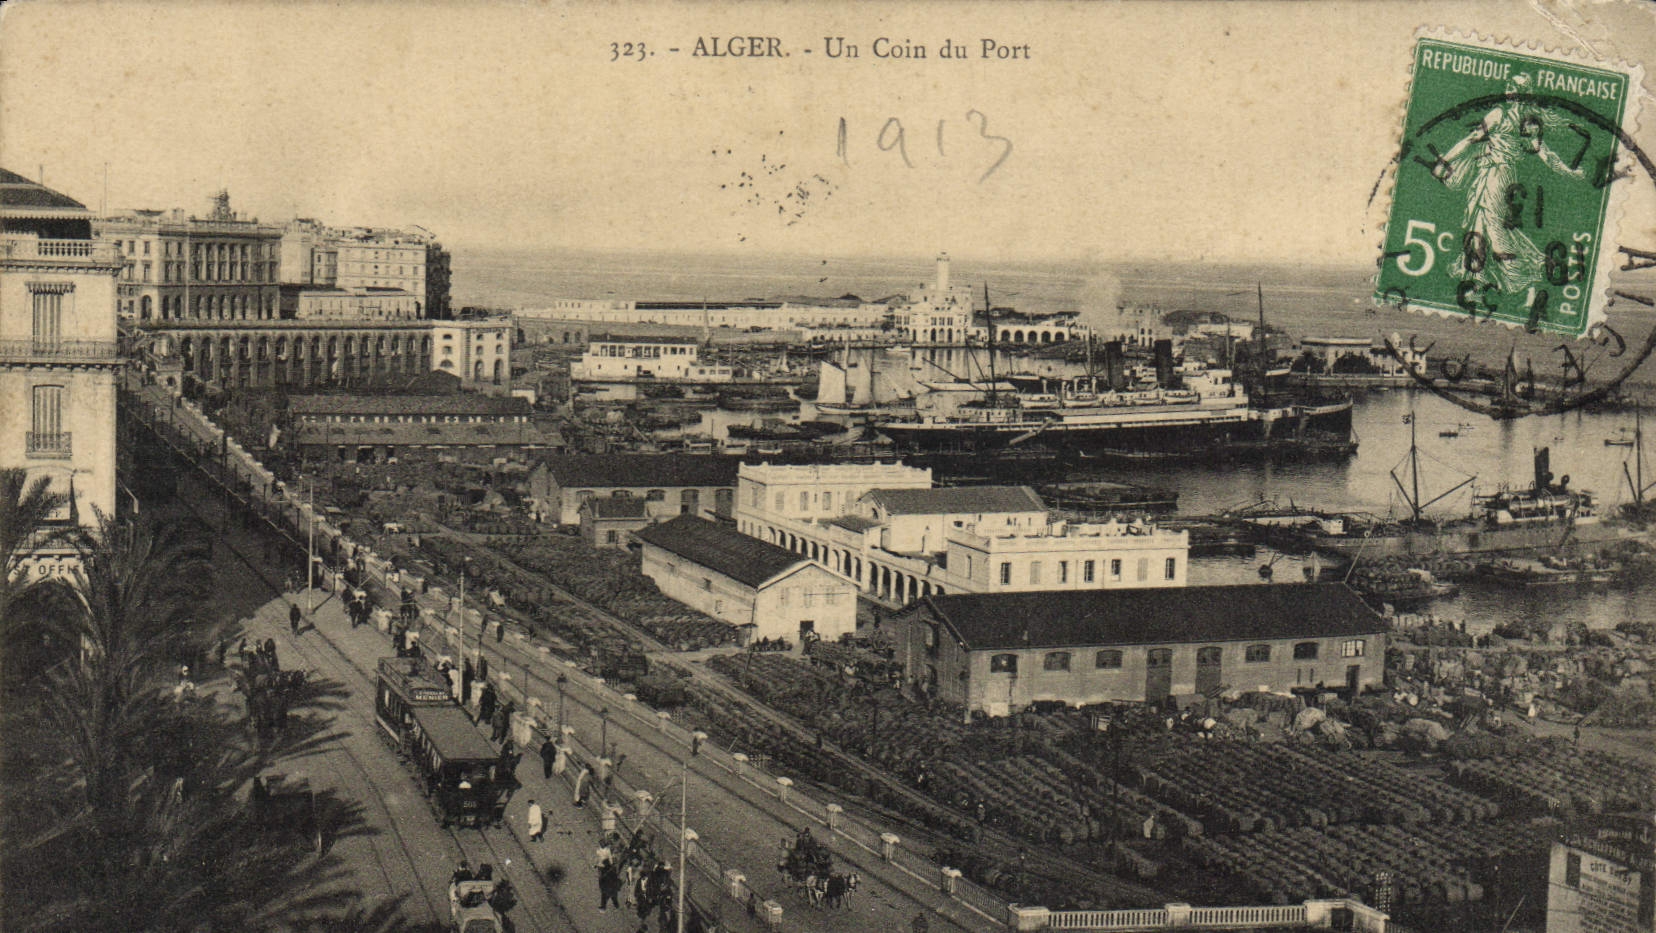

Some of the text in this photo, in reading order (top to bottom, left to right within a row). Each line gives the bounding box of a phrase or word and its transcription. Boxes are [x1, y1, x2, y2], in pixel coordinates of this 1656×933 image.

[1422, 49, 1618, 100] REPUBLIQUE FRANÇAISE
[835, 108, 1013, 184] 1913
[1559, 231, 1592, 316] POSTES
